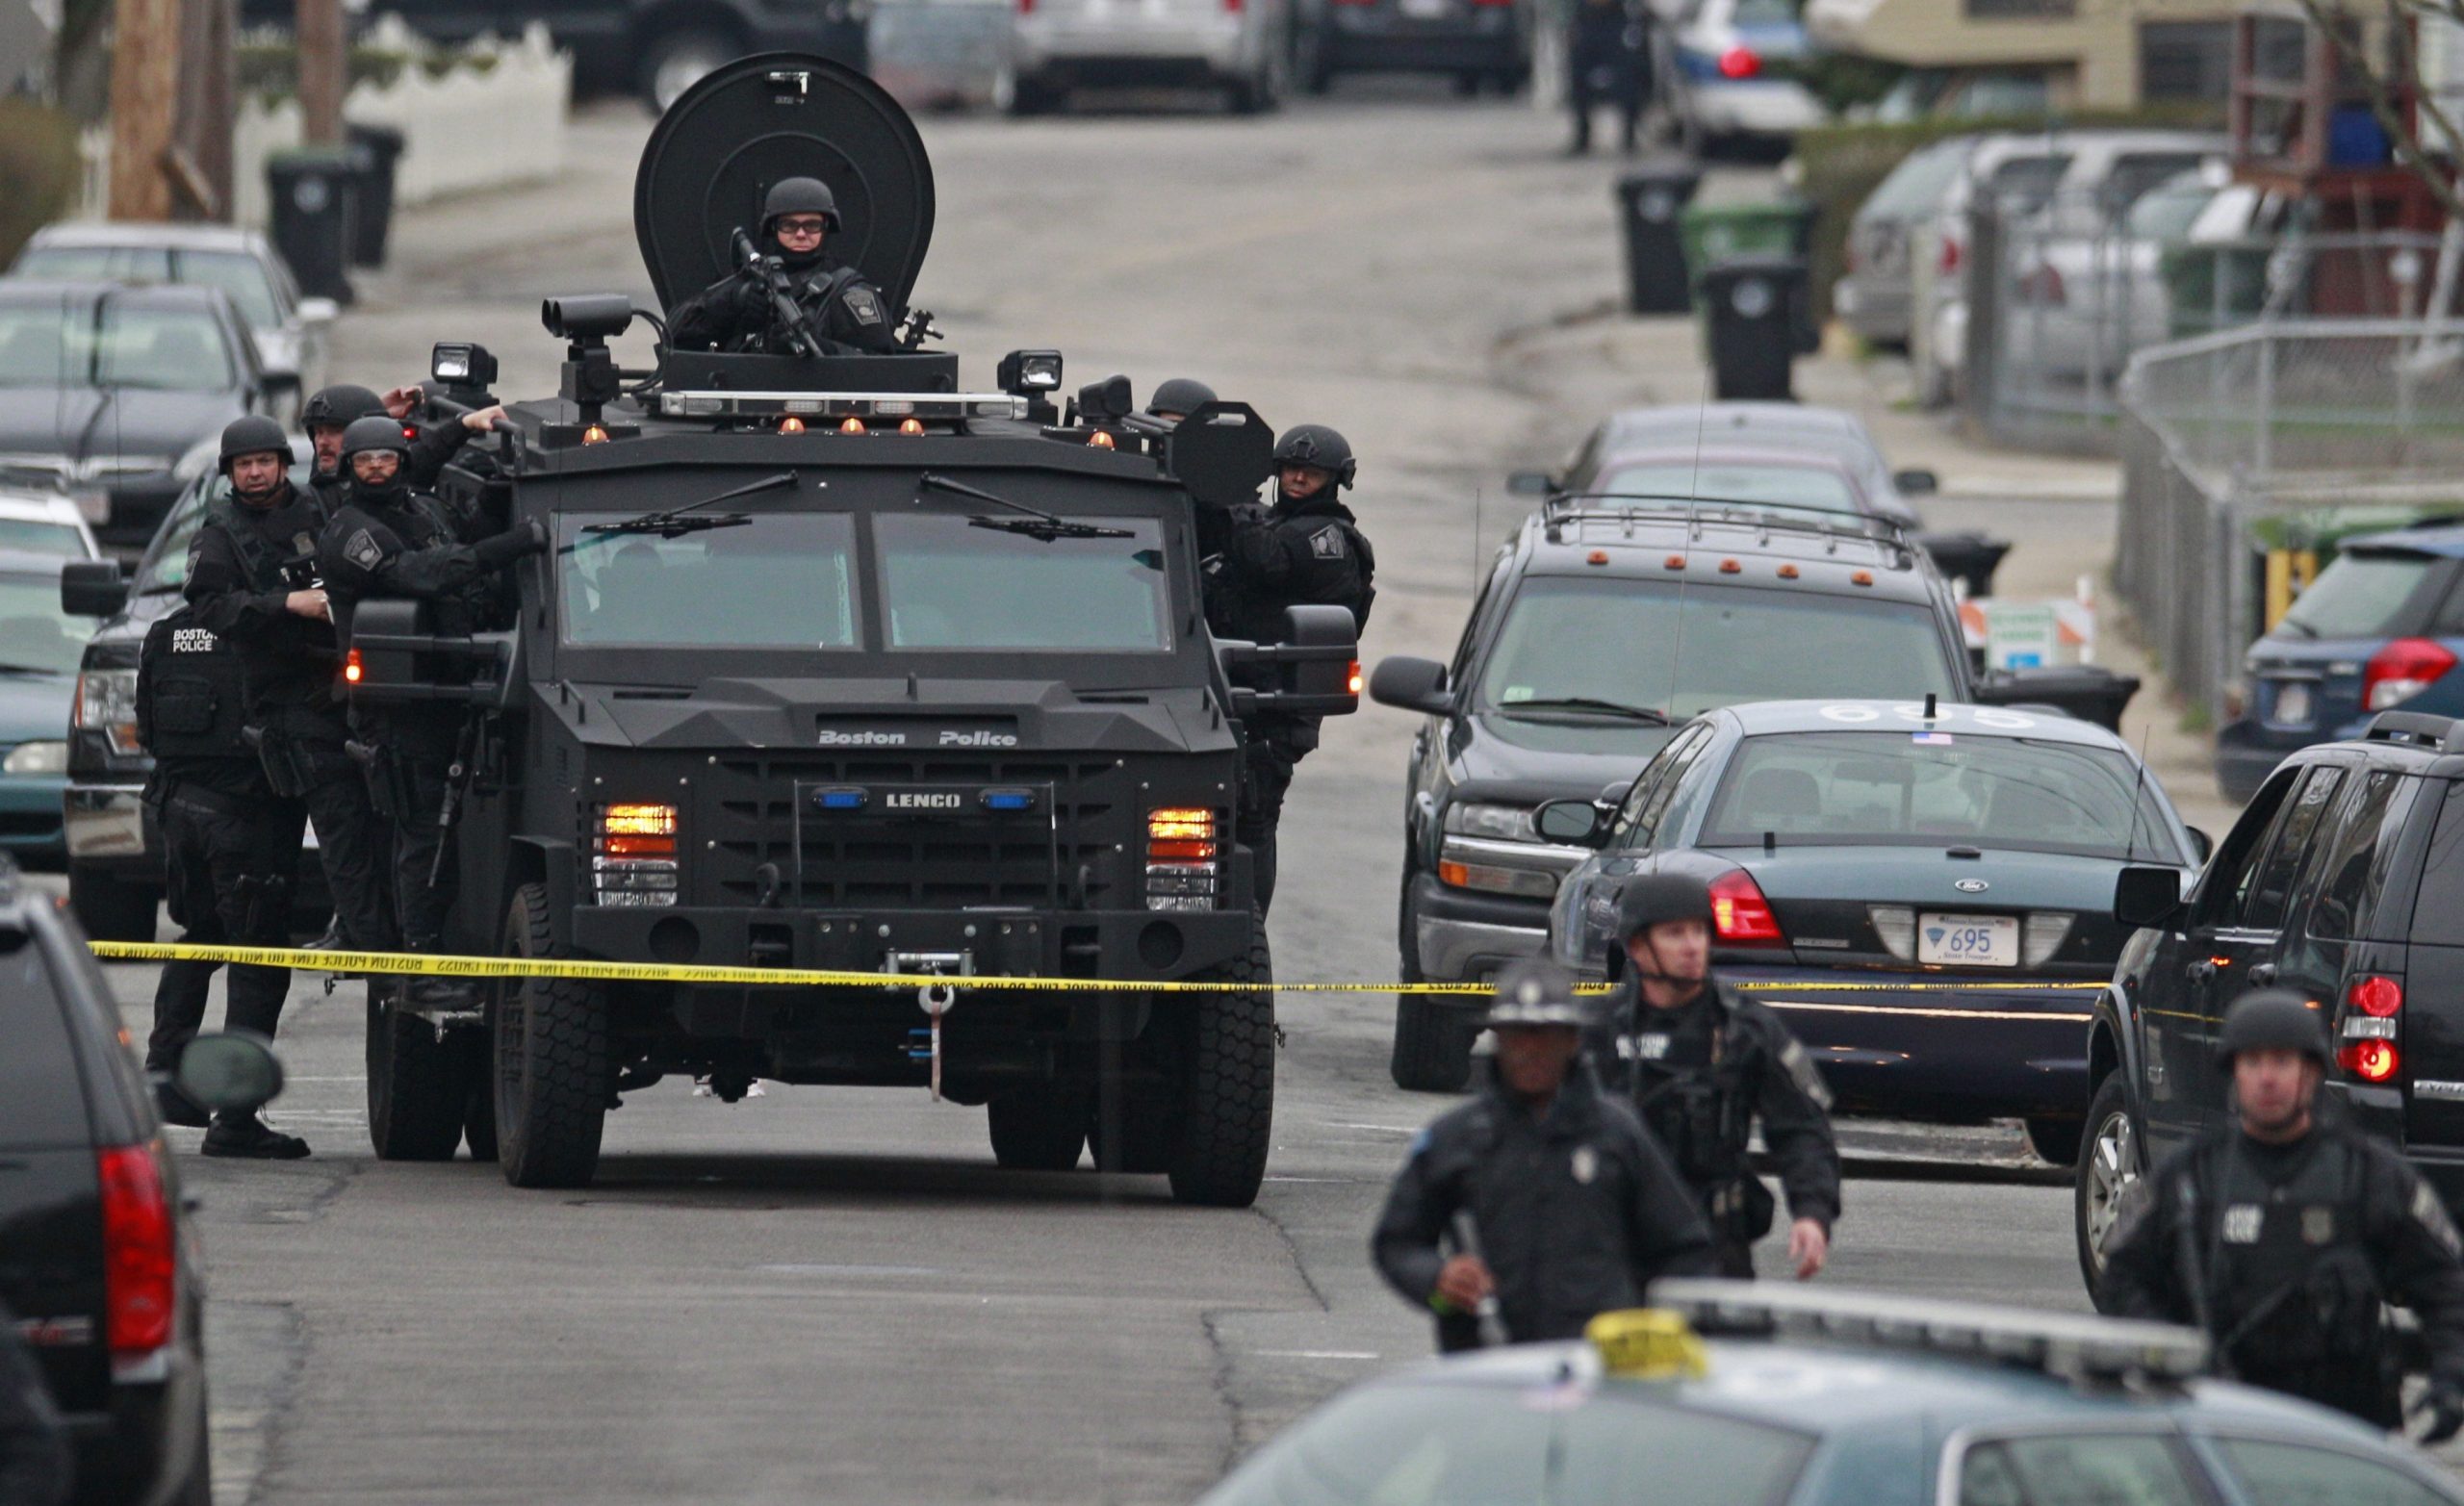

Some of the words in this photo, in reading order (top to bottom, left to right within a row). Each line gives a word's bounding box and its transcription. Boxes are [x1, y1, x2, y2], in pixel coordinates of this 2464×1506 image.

[173, 628, 218, 641] BOSTO
[173, 640, 213, 652] POLICE
[818, 729, 906, 745] Boston
[939, 730, 1017, 747] Police
[886, 793, 961, 808] LENCO
[1950, 928, 1990, 953] 695
[1943, 952, 1963, 960] State
[1964, 953, 1992, 961] Trooper
